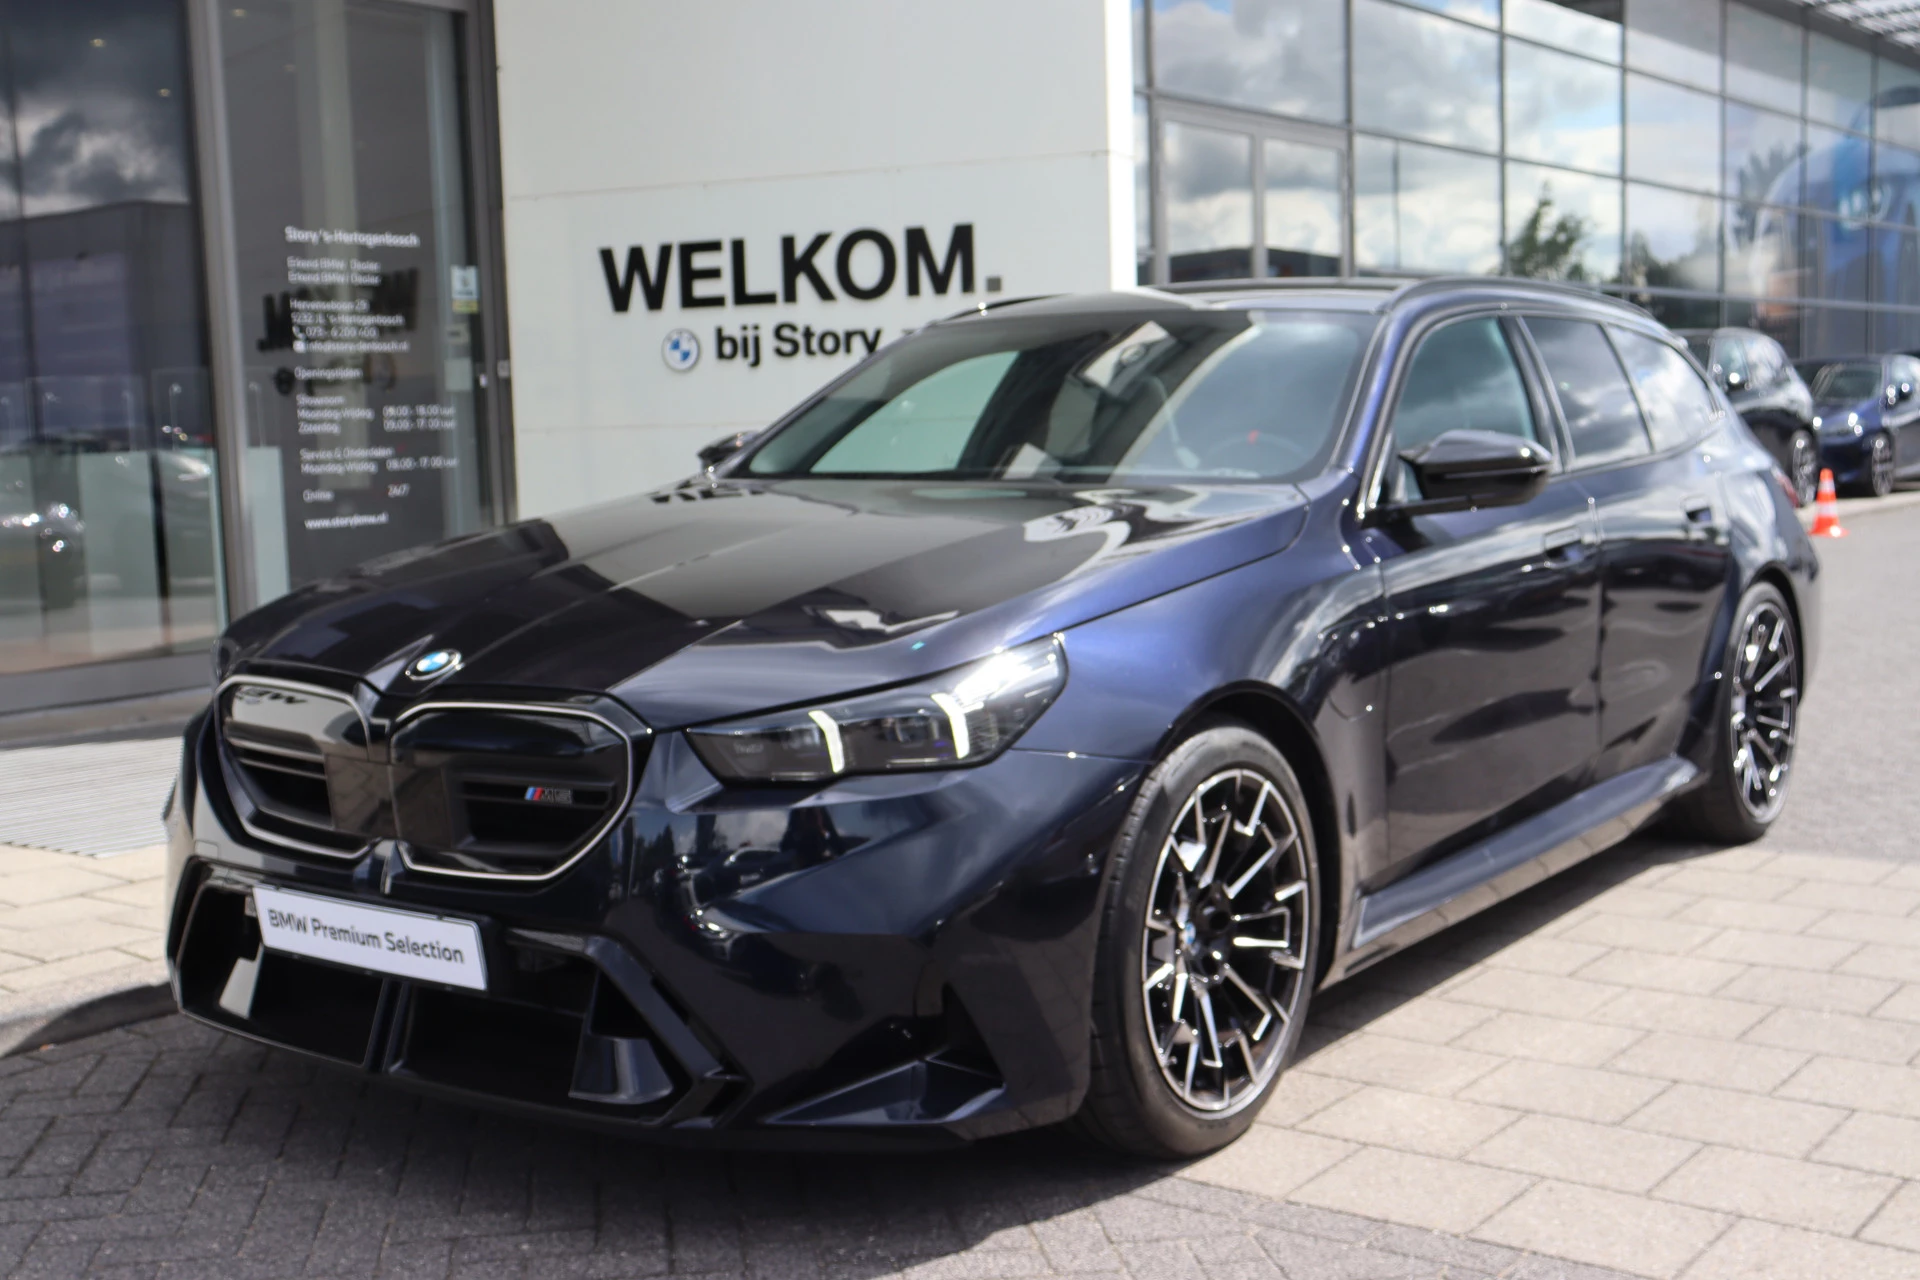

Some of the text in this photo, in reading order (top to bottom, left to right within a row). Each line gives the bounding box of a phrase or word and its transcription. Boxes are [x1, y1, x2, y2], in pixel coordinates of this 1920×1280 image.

[285, 226, 319, 245] Story
[598, 222, 1003, 313] WELKOM.
[715, 322, 883, 368] bij Story
[267, 909, 465, 964] BMW Premium Selection
